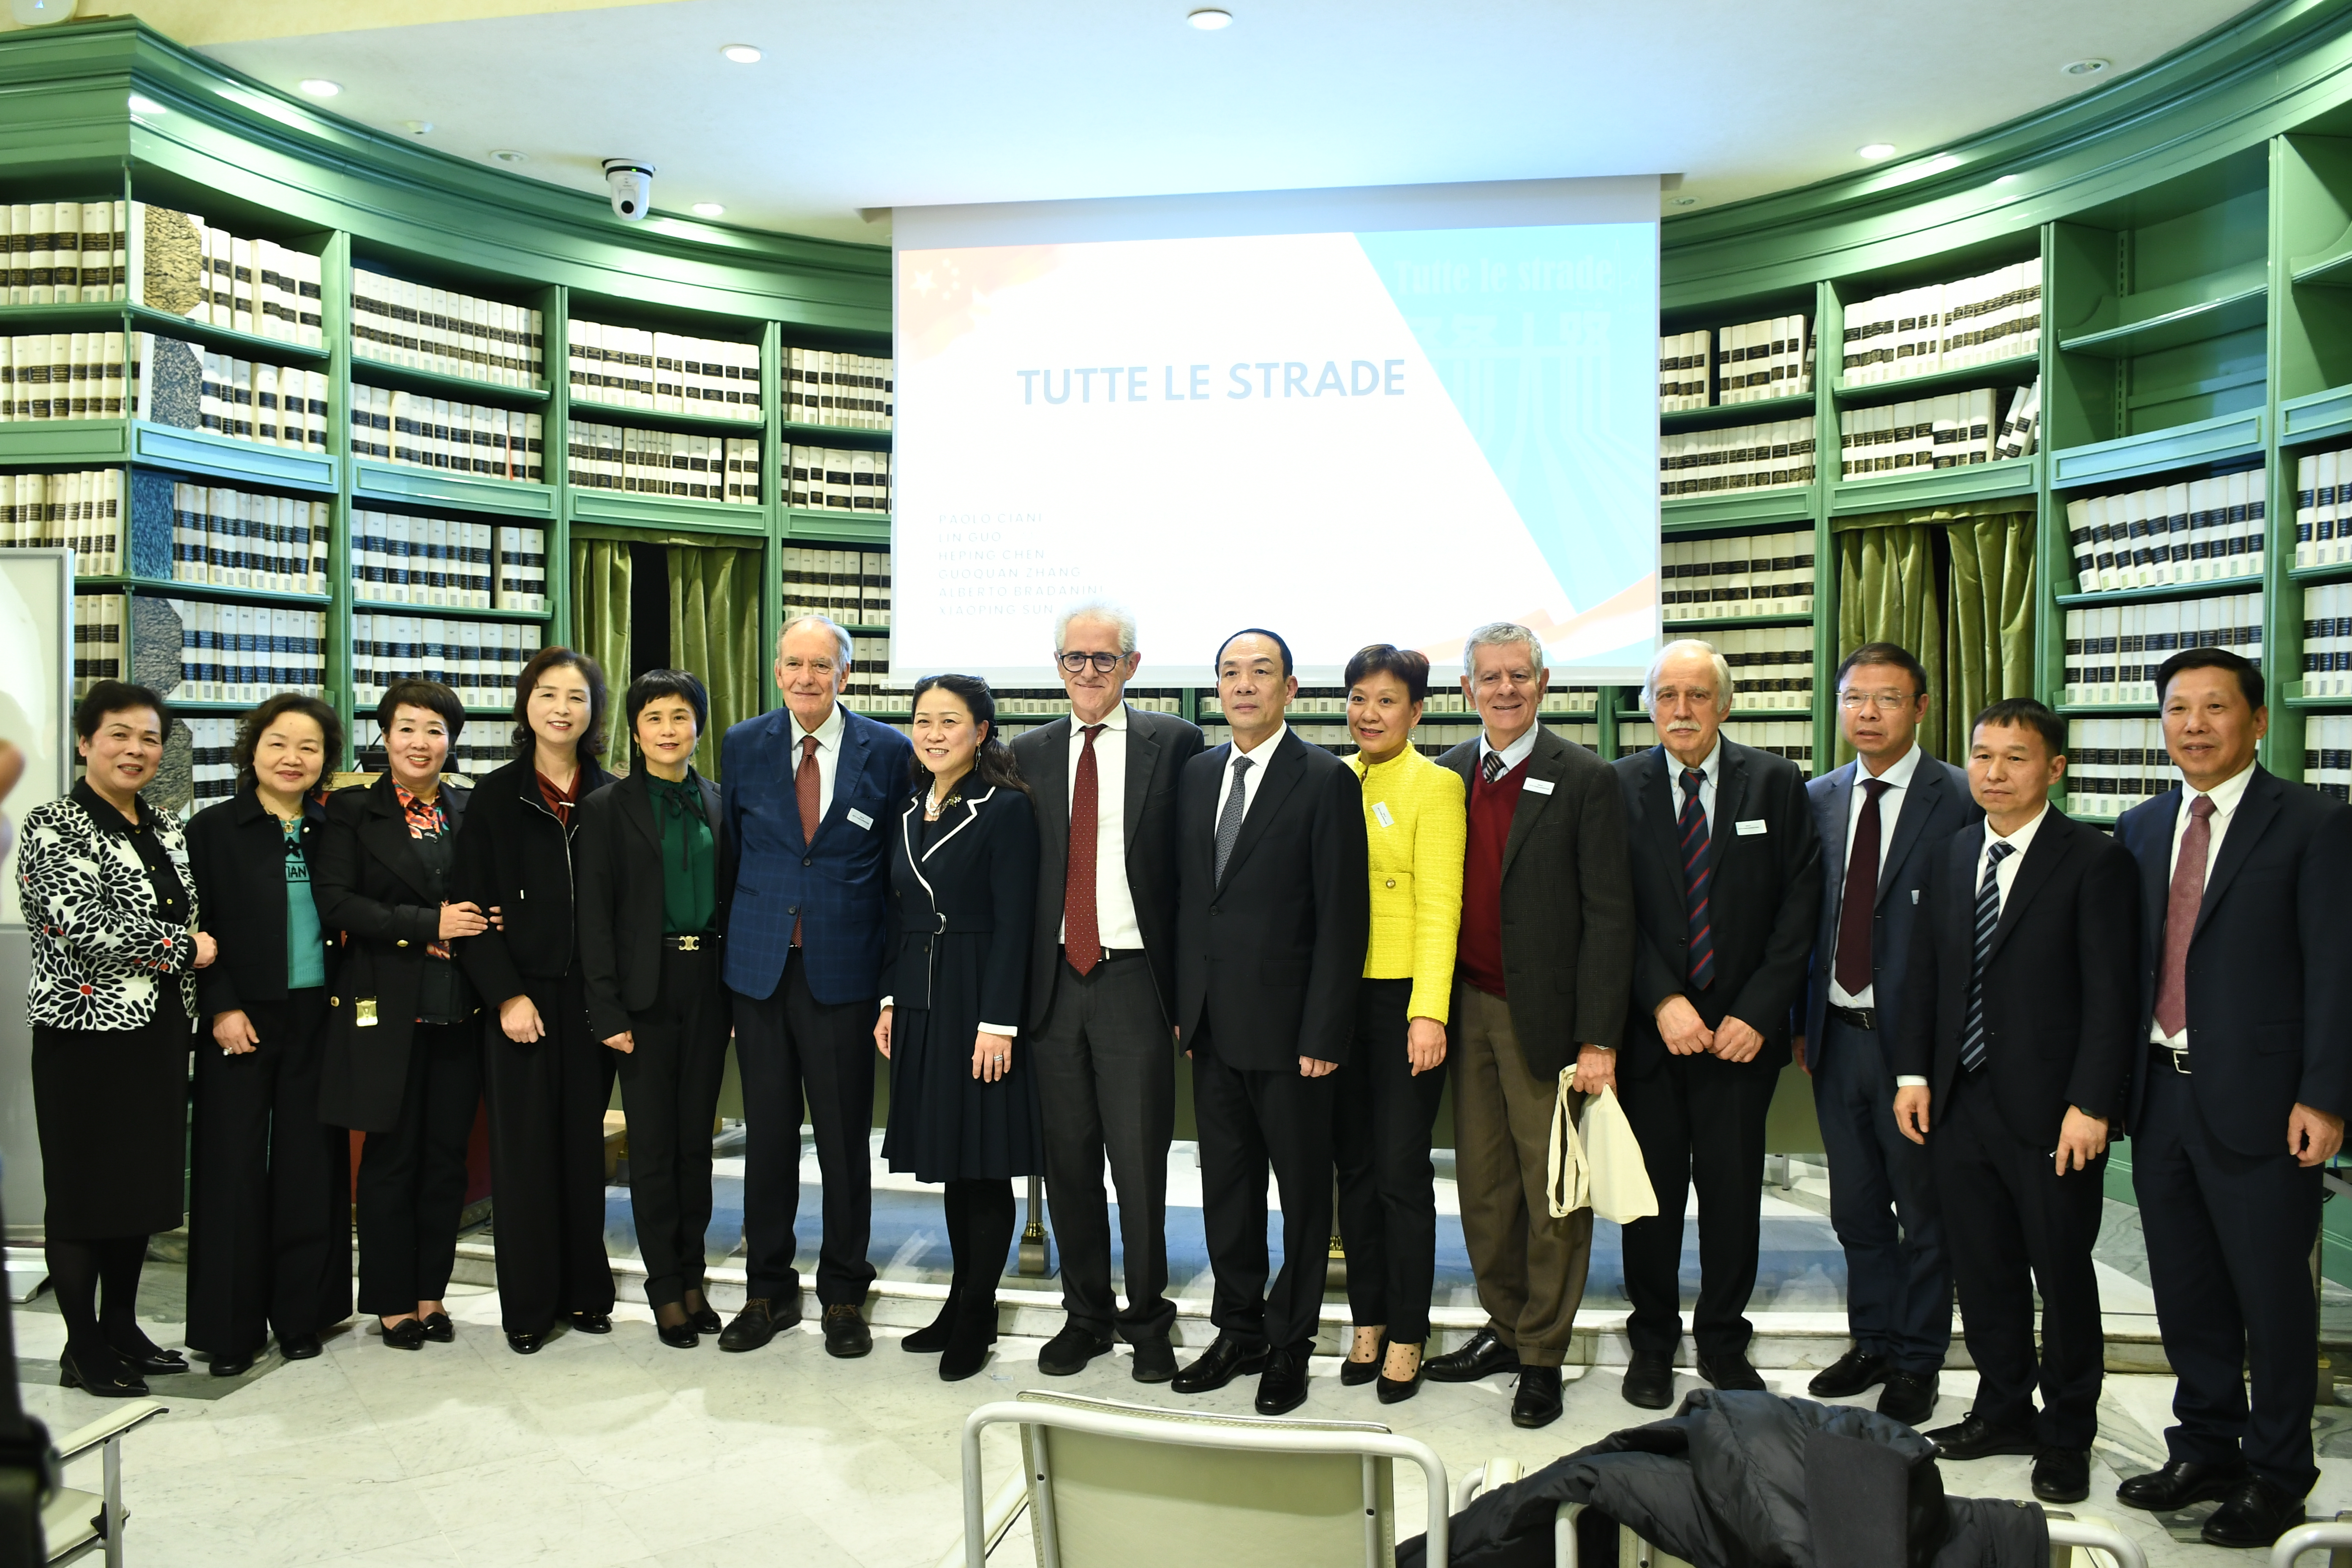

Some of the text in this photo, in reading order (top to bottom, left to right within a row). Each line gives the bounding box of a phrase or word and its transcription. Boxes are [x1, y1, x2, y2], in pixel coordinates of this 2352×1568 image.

[1394, 255, 1614, 295] Tutte le strade
[1016, 359, 1405, 405] TUTTE LE STRADE
[939, 513, 1042, 524] PAOLO CIANI
[939, 532, 1001, 542] LIN GUO
[939, 550, 1044, 561] HEPING CHEN
[938, 567, 1081, 580] GUOQUAN ZHANG
[939, 585, 1103, 597] ALBERTO BRADANINI
[939, 604, 1053, 615] XIAOPING SUN
[286, 866, 307, 878] IAN
